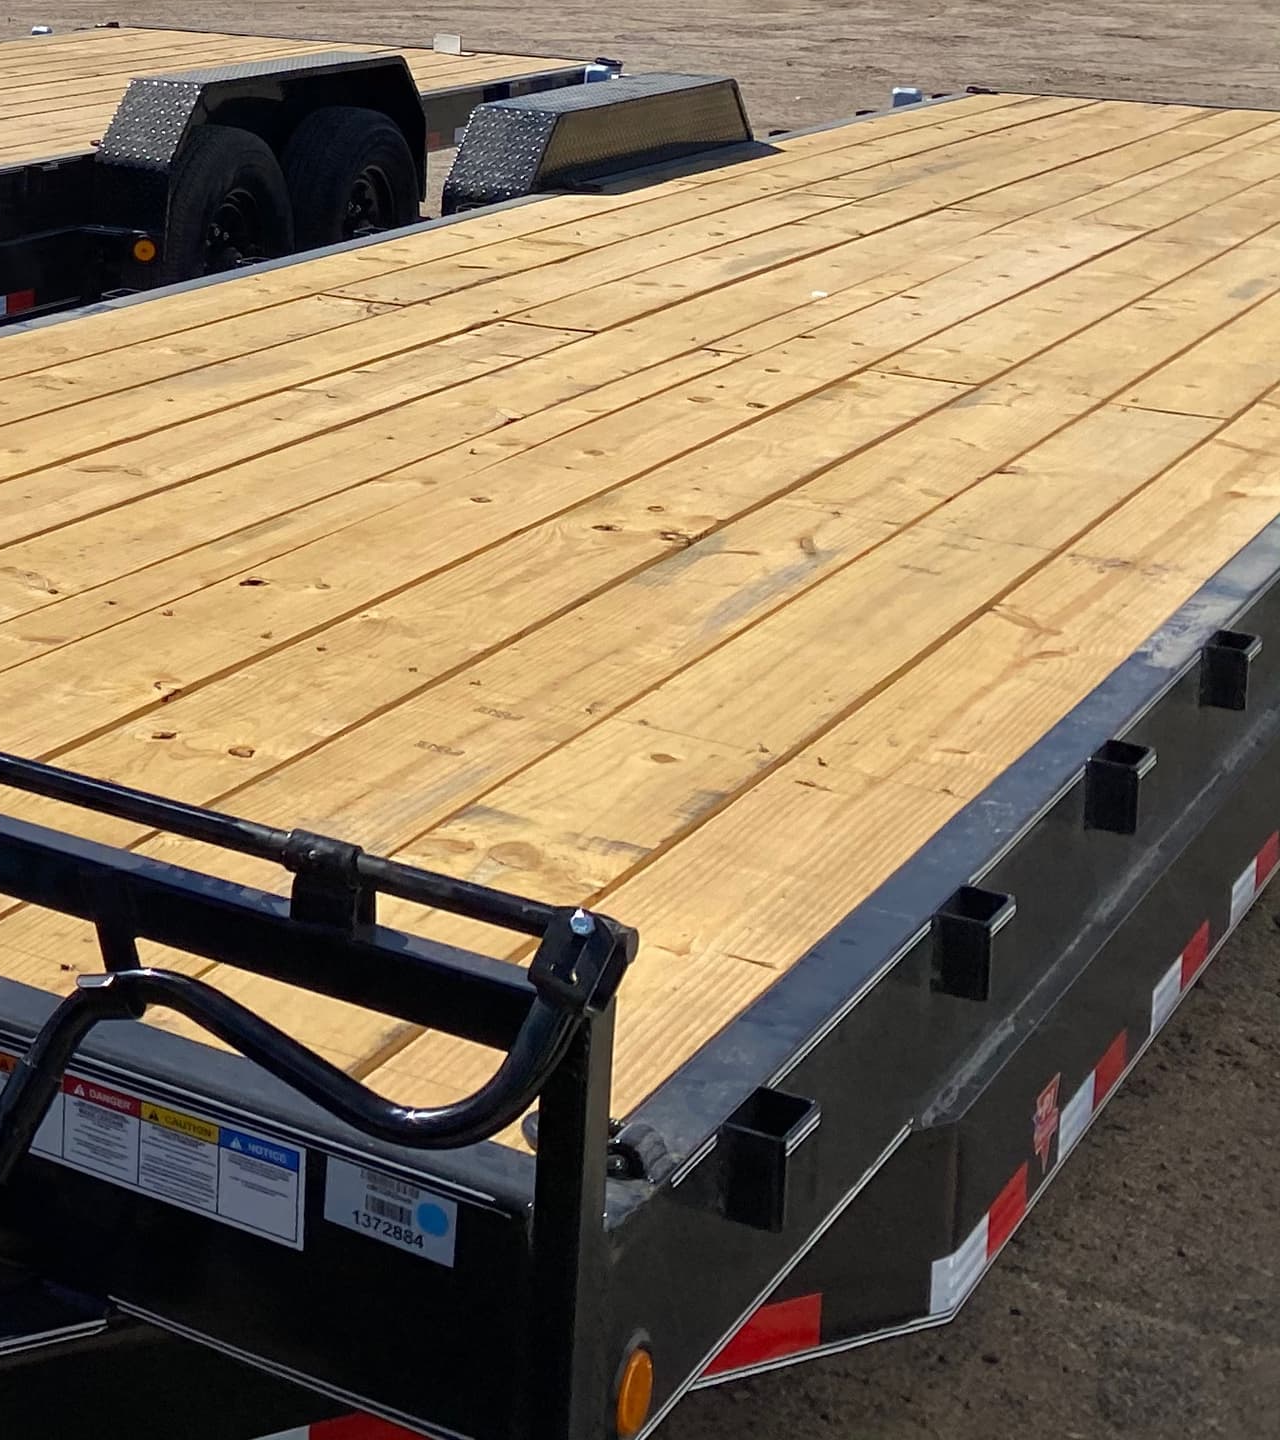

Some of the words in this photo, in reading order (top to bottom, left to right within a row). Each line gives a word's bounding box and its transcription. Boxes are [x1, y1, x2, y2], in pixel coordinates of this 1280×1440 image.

[89, 1089, 132, 1110] DANGER
[164, 1115, 212, 1138] CAUTION
[248, 1142, 288, 1164] NOTICE
[352, 1209, 424, 1249] 1372884
